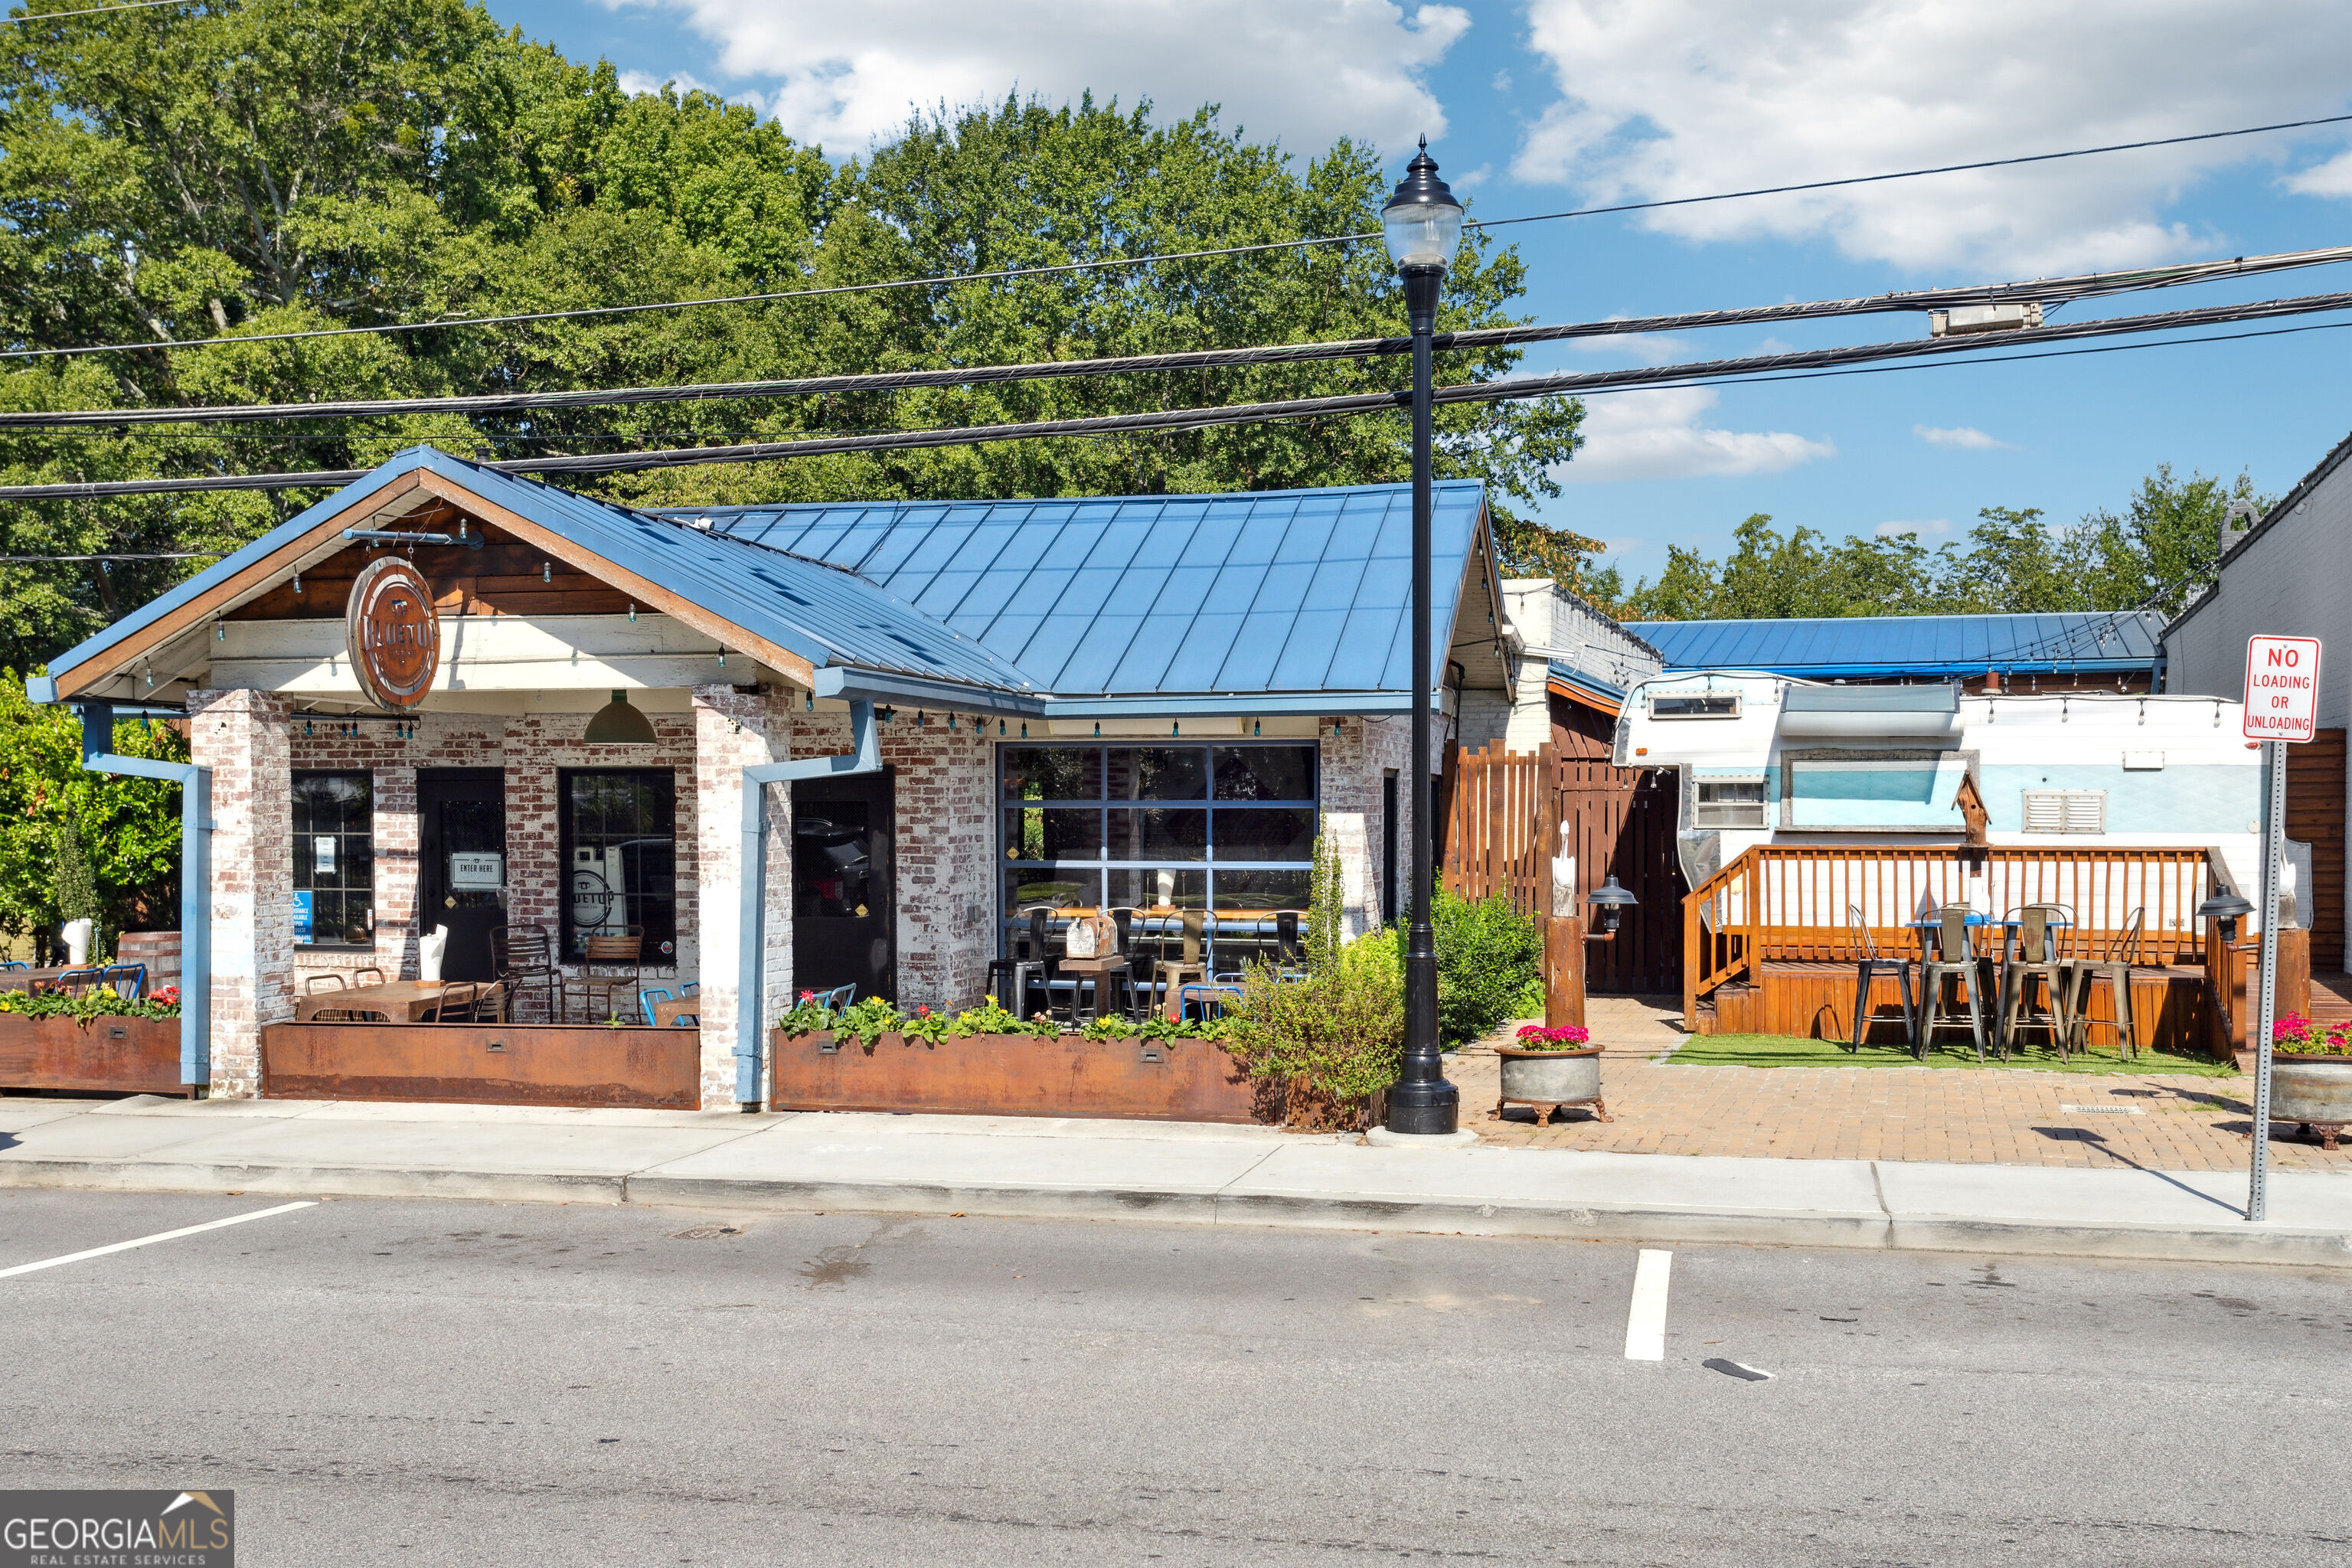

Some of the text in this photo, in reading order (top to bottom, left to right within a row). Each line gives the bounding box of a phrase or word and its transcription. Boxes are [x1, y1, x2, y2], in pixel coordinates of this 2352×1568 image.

[364, 615, 436, 651] BLUETOP
[2268, 648, 2298, 668] NO
[2253, 674, 2310, 689] LOADING
[2271, 695, 2288, 709] OR
[2247, 714, 2310, 730] UNLOADING
[460, 864, 493, 873] ENTER HERE
